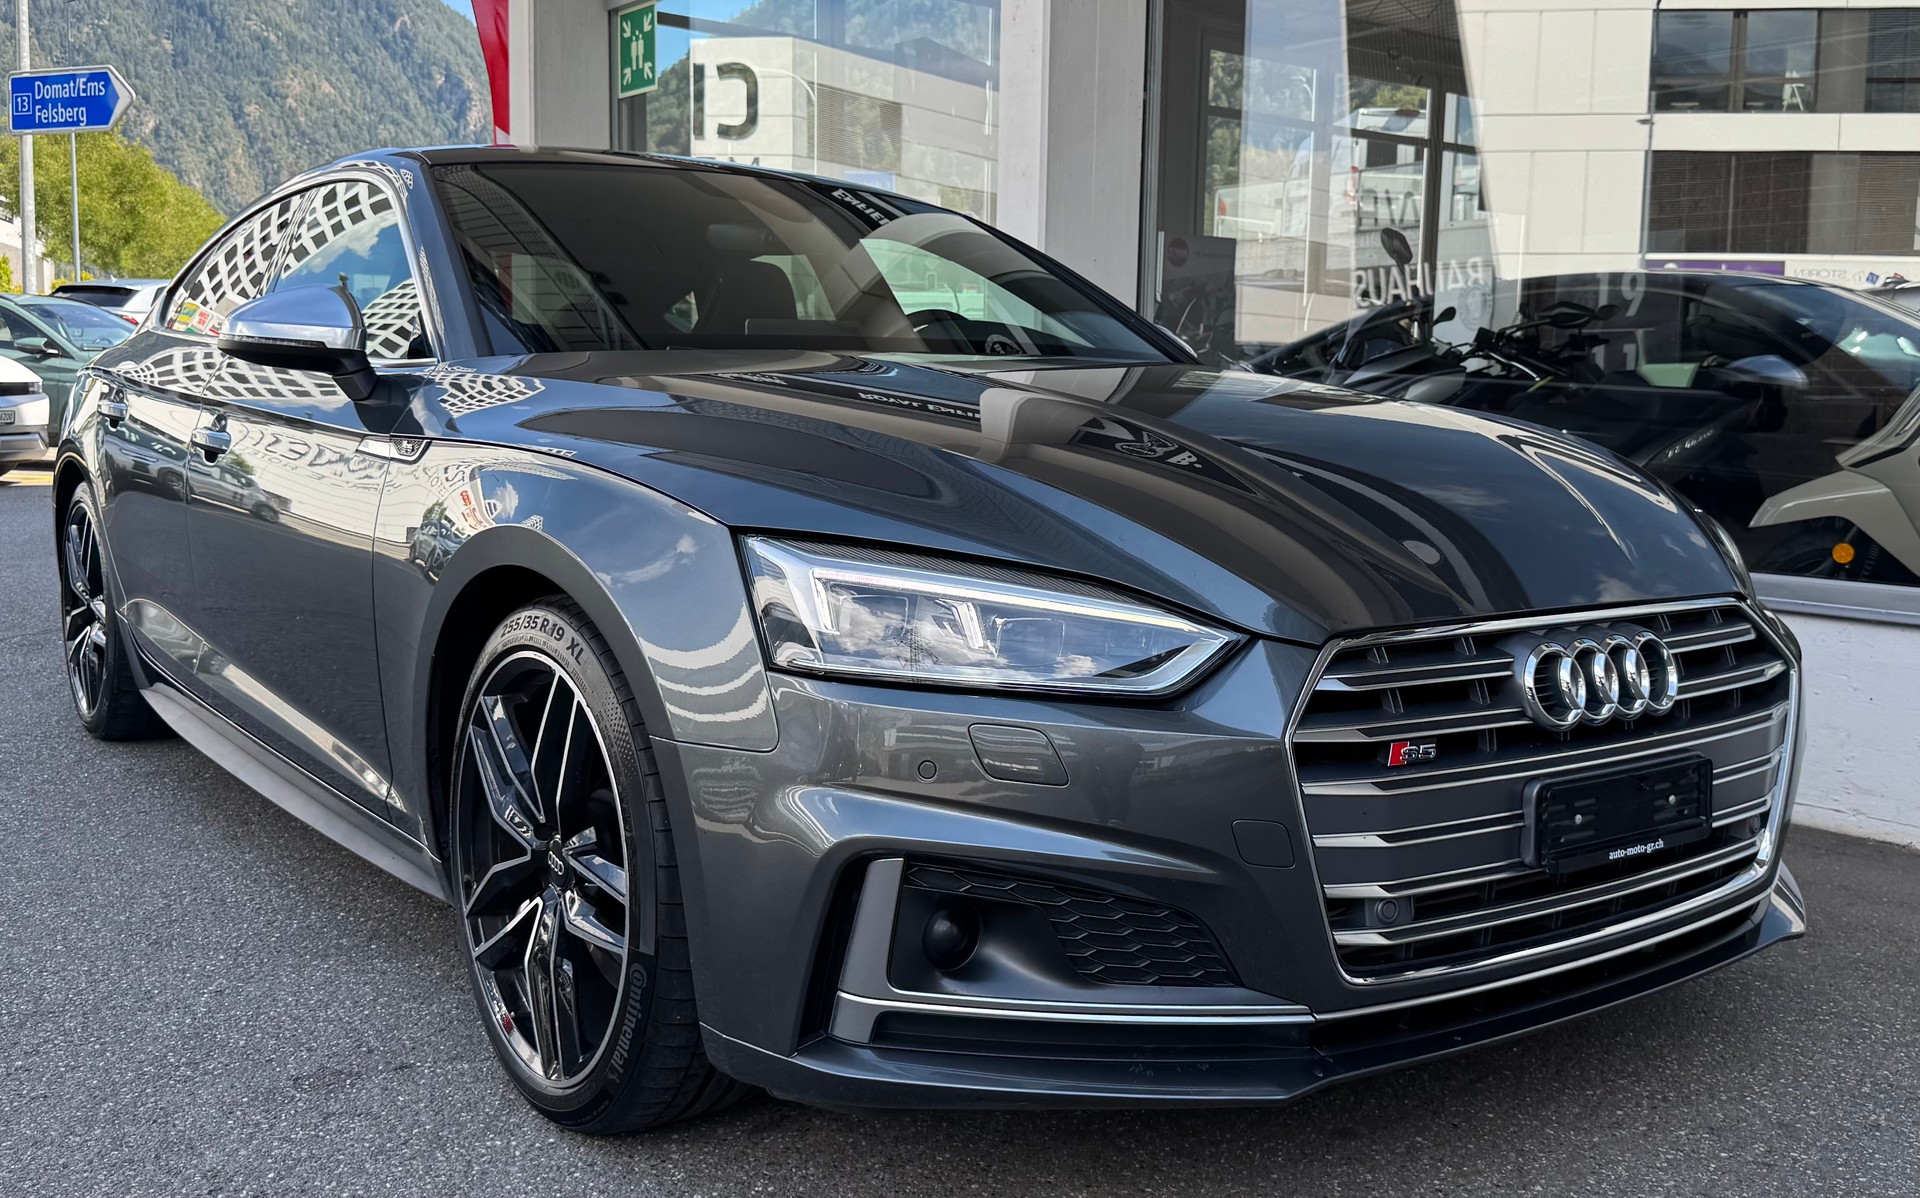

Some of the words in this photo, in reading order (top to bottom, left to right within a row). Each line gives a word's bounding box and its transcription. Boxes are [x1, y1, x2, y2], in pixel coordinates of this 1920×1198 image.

[35, 78, 106, 100] Domat/Ems
[17, 96, 29, 112] 13
[35, 102, 87, 126] Felsberg
[500, 614, 542, 639] 255/35
[566, 636, 585, 666] XL
[1398, 743, 1437, 761] S5
[1608, 838, 1664, 859] auto-moto-gr.ch
[611, 962, 648, 1072] Continental
